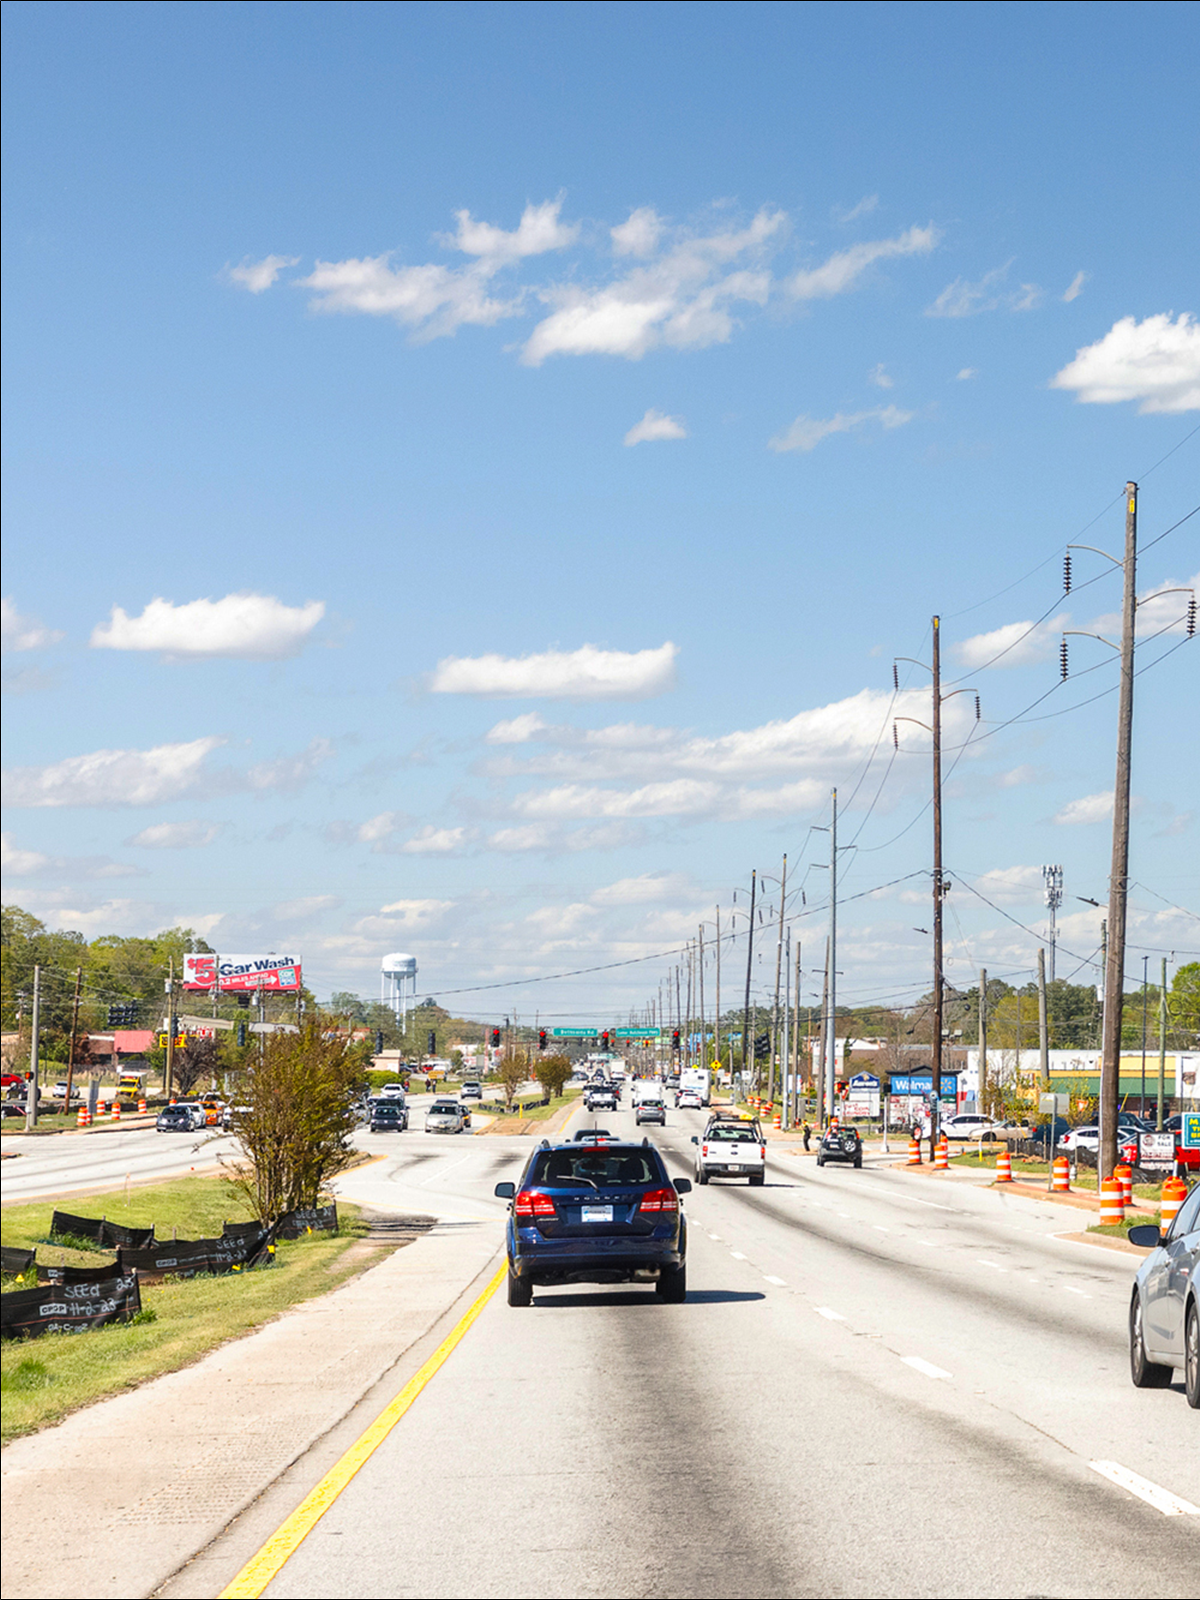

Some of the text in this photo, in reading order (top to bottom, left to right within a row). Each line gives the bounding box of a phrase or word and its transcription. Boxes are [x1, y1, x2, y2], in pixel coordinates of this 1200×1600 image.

[187, 956, 295, 984] $5 Car Wash
[895, 1080, 933, 1091] Walma
